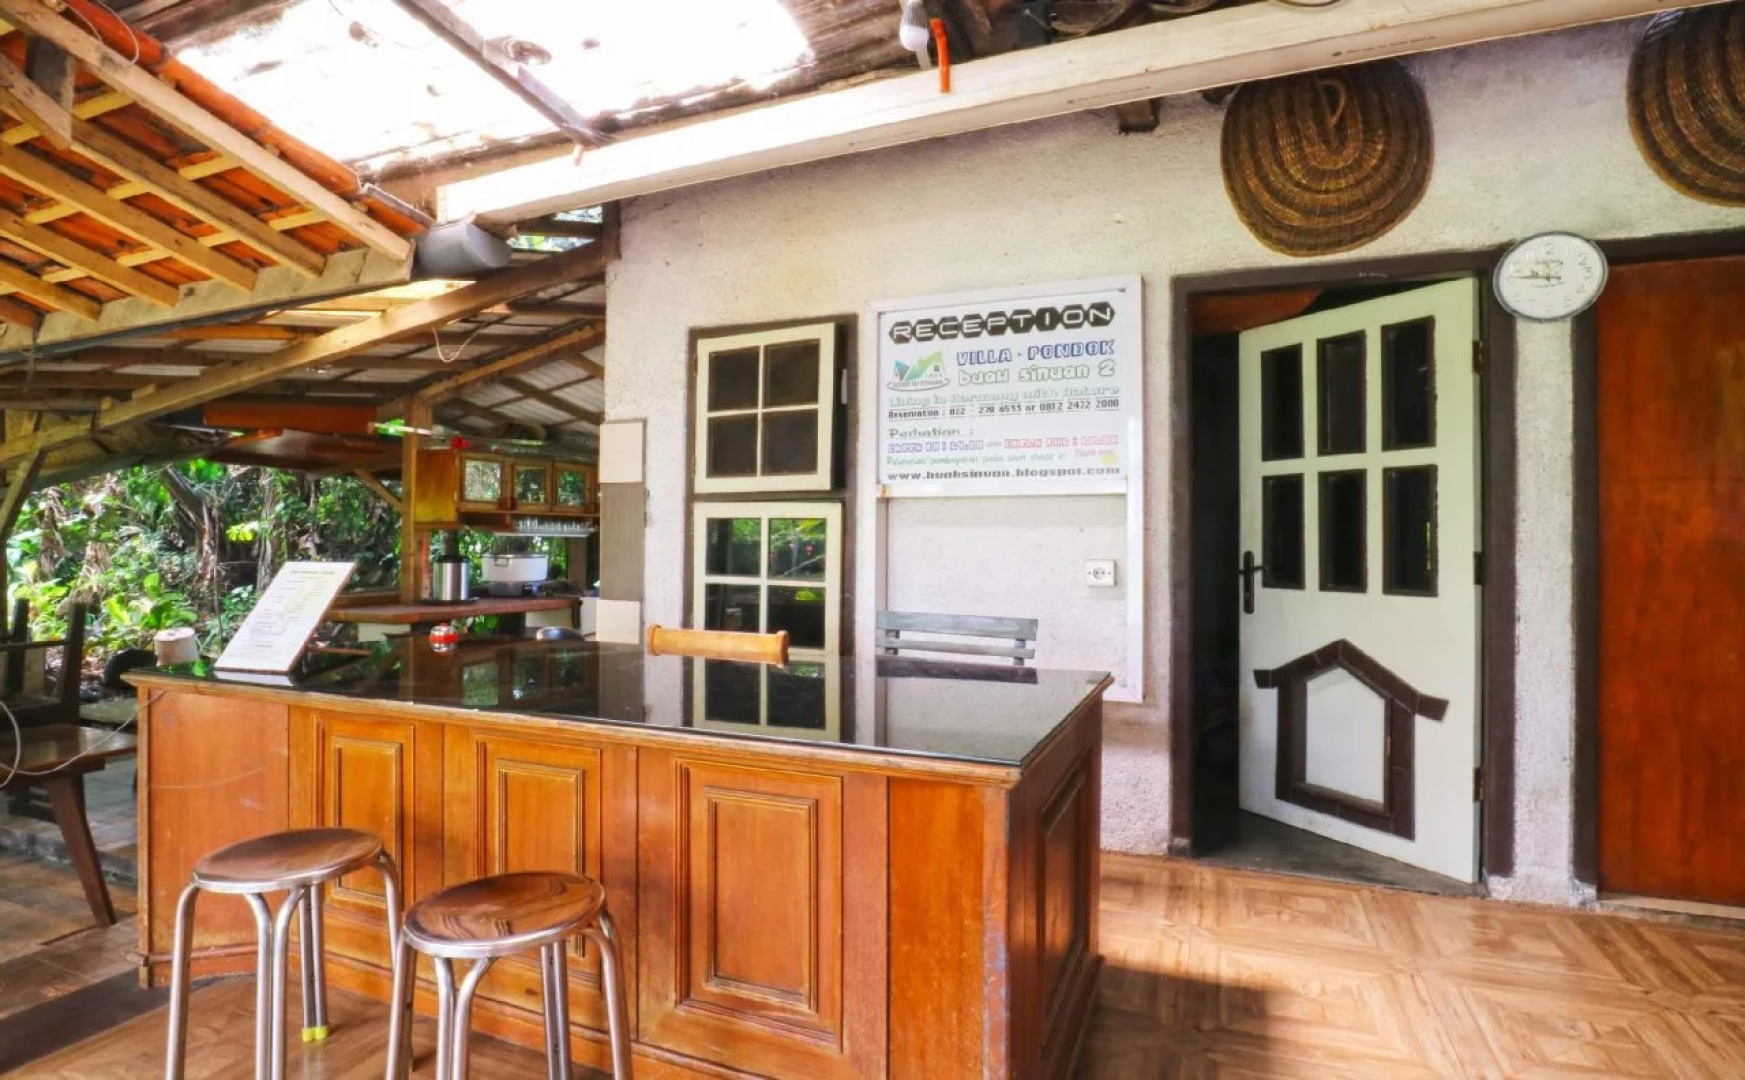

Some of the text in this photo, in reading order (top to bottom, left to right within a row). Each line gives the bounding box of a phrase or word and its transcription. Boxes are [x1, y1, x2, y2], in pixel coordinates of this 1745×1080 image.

[891, 305, 1113, 341] RECEPTION
[957, 348, 1012, 366] VILLA
[1027, 339, 1115, 360] PONDOK
[1098, 358, 1116, 377] 2
